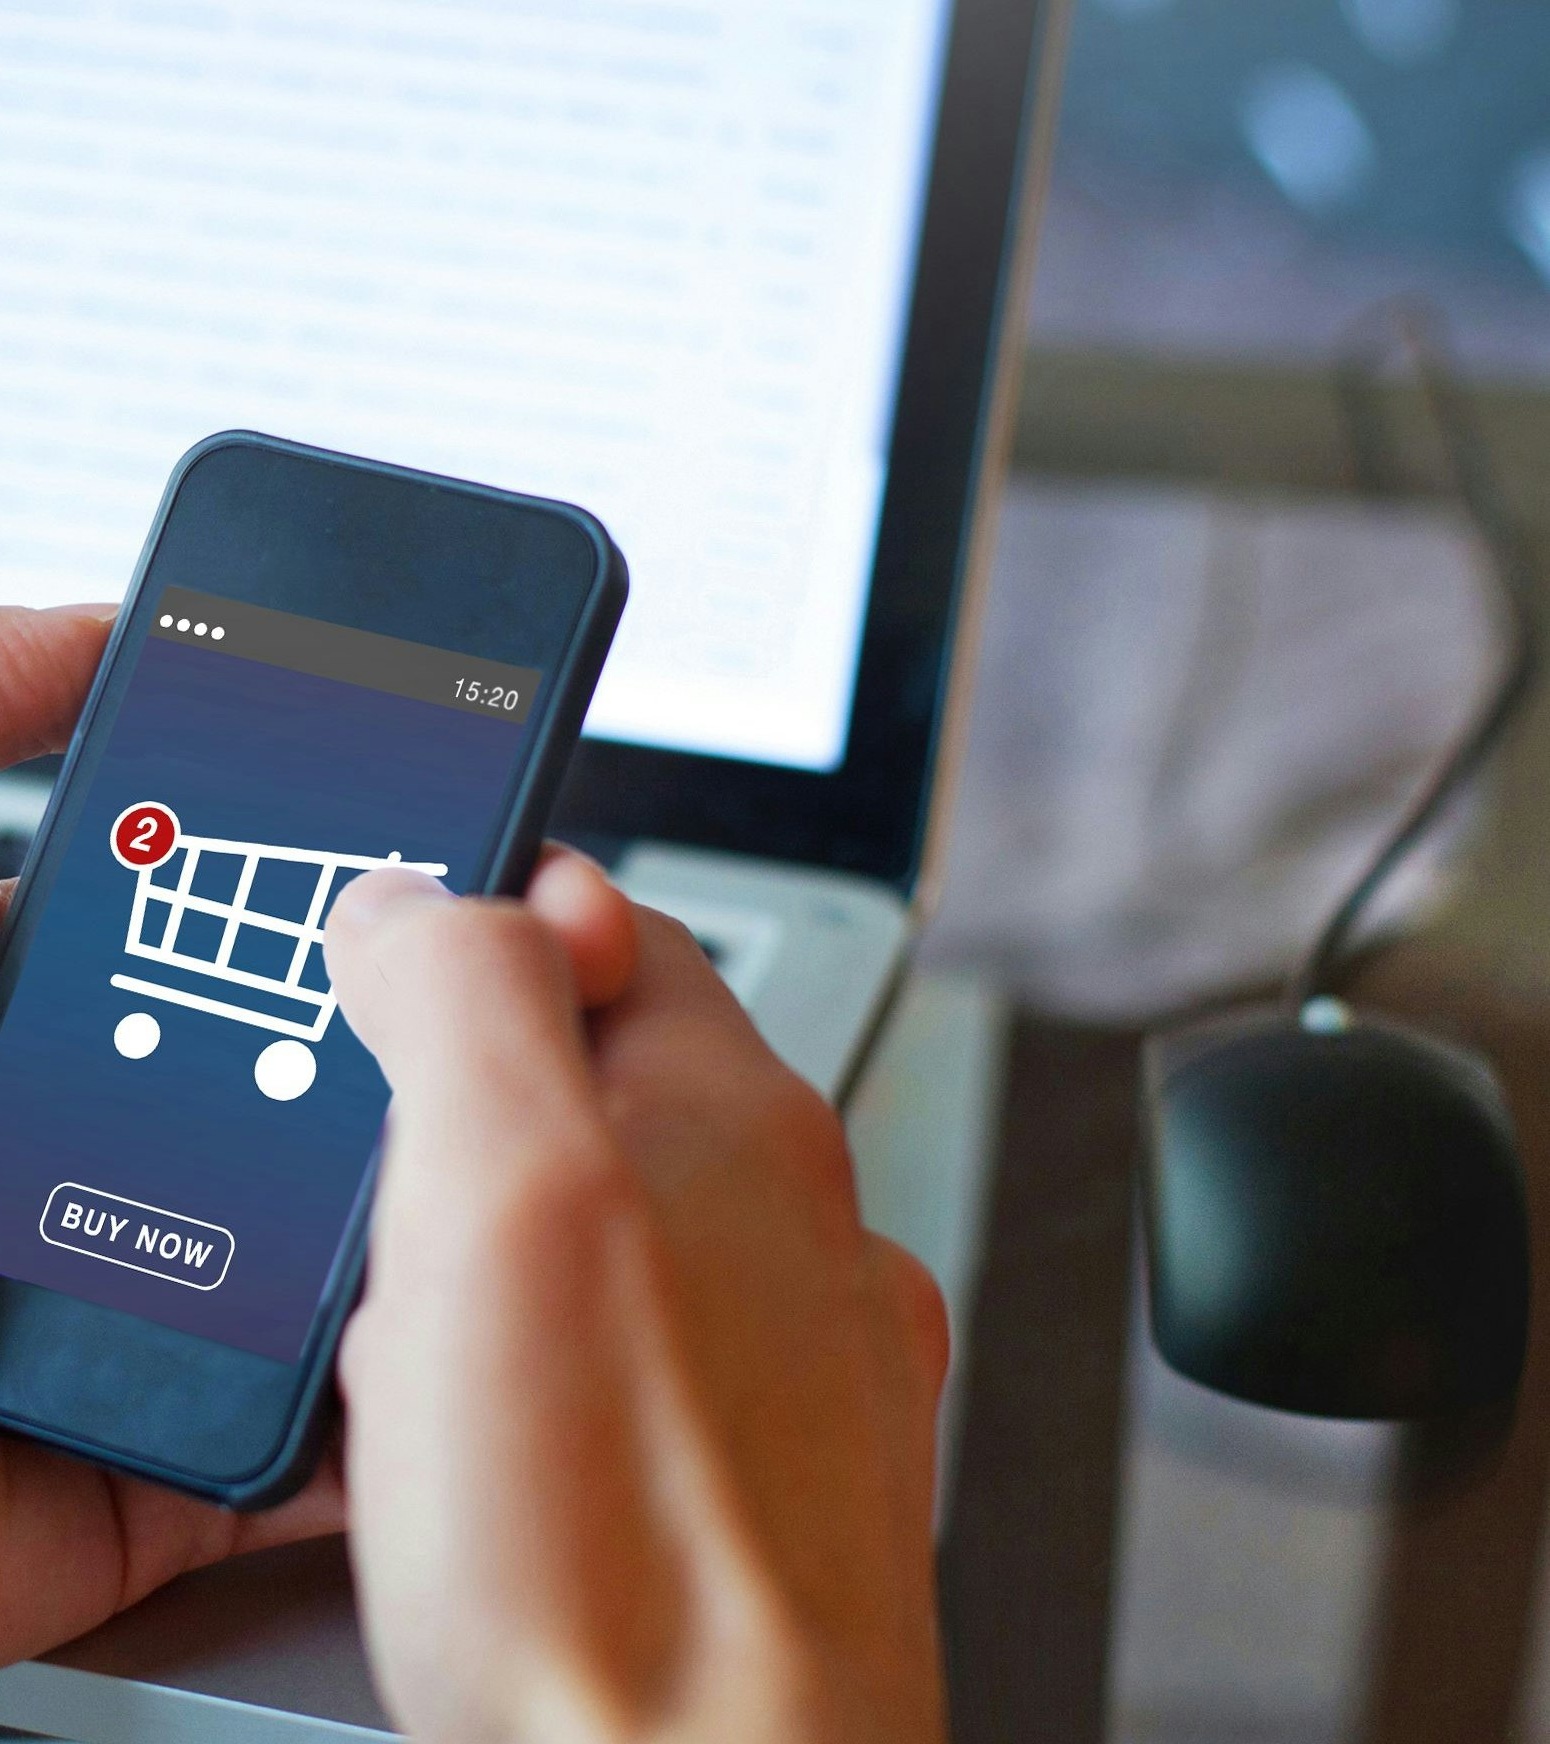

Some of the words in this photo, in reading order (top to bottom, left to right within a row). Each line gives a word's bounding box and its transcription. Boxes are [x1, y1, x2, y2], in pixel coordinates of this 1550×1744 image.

[454, 678, 519, 710] 15:20
[129, 816, 158, 851] 2
[60, 1202, 130, 1242] BUY
[134, 1224, 214, 1268] NOW
